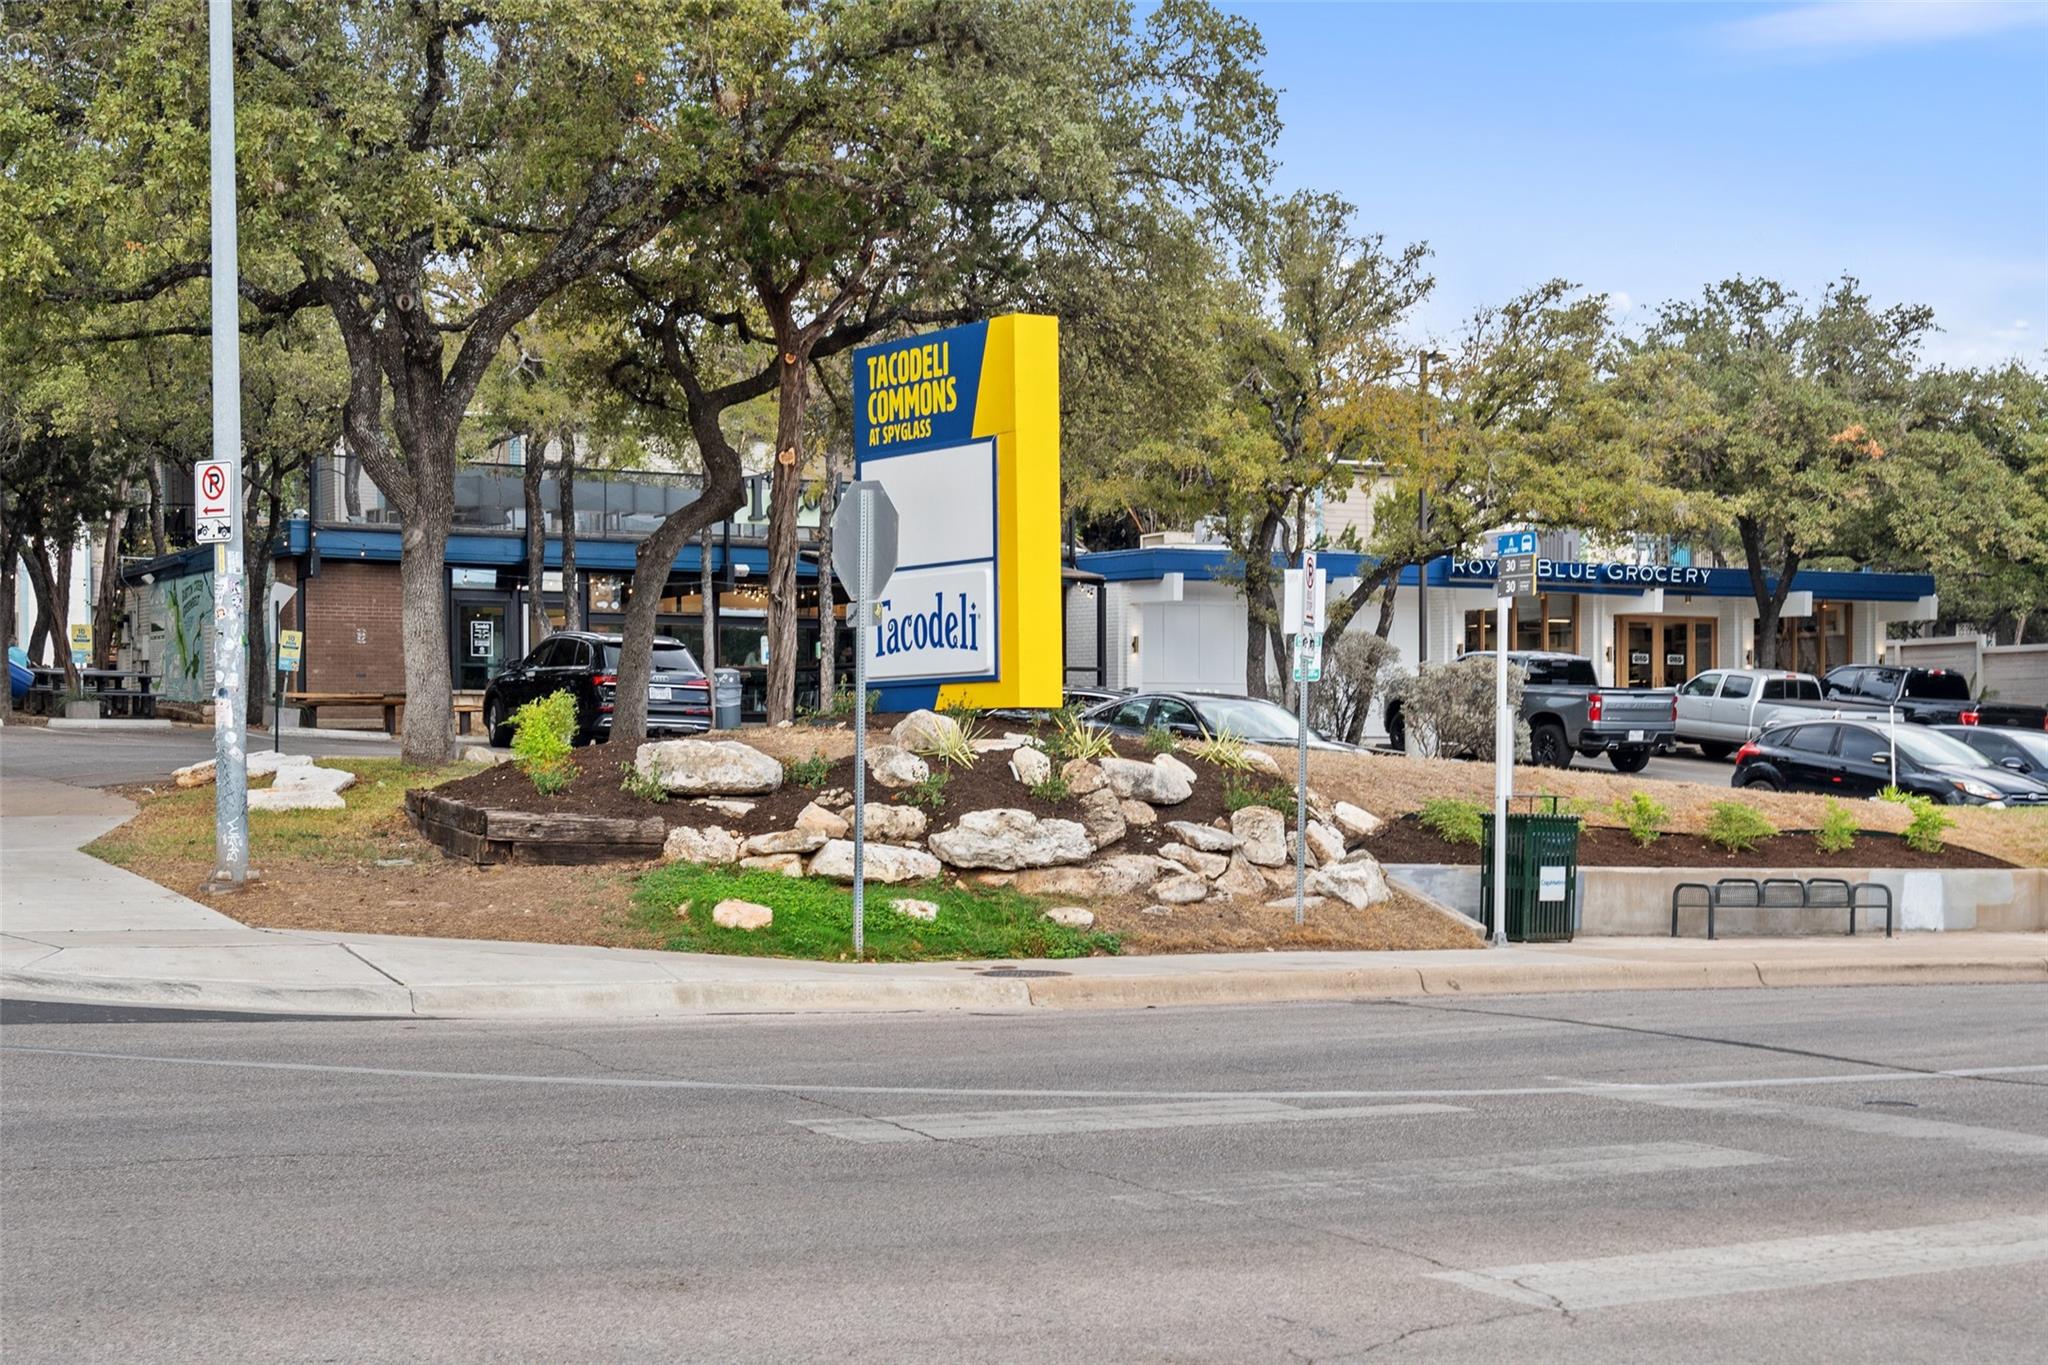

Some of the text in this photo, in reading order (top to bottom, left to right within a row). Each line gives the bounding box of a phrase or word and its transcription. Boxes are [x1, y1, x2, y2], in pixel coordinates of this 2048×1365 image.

[867, 341, 949, 390] TACODELI
[868, 376, 957, 425] COMMONS
[869, 418, 932, 447] AT SPYGLASS
[1452, 557, 1497, 575] ROY
[1537, 559, 1597, 580] BLUE
[1607, 563, 1711, 585] GROCERY
[1505, 559, 1516, 572] 30
[1505, 580, 1516, 593] 30
[875, 592, 978, 657] Tacodeli
